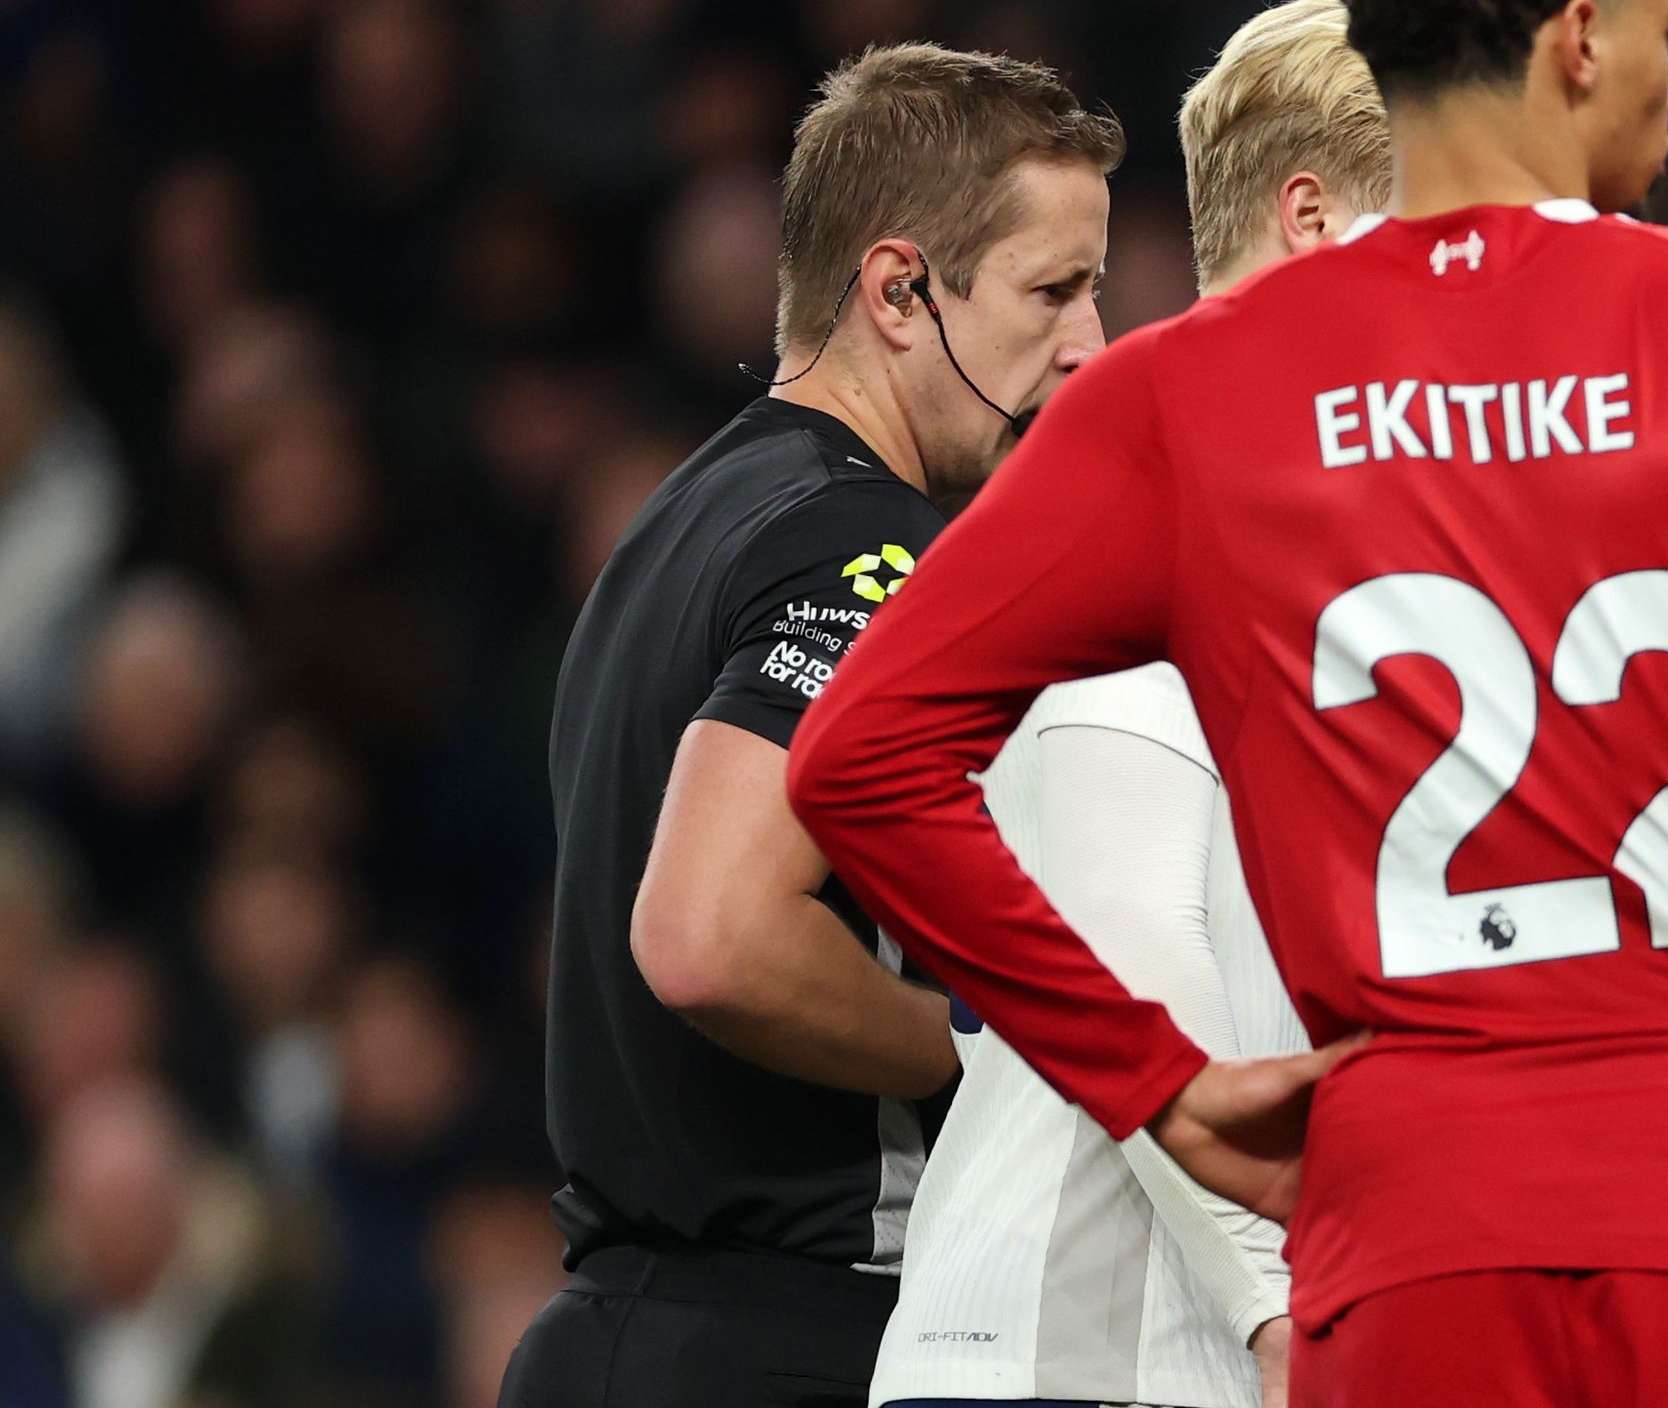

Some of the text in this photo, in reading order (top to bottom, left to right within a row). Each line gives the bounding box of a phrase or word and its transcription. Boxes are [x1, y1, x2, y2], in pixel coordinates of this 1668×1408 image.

[1314, 373, 1635, 469] EKITIKE
[773, 620, 843, 652] Building
[770, 640, 806, 667] No
